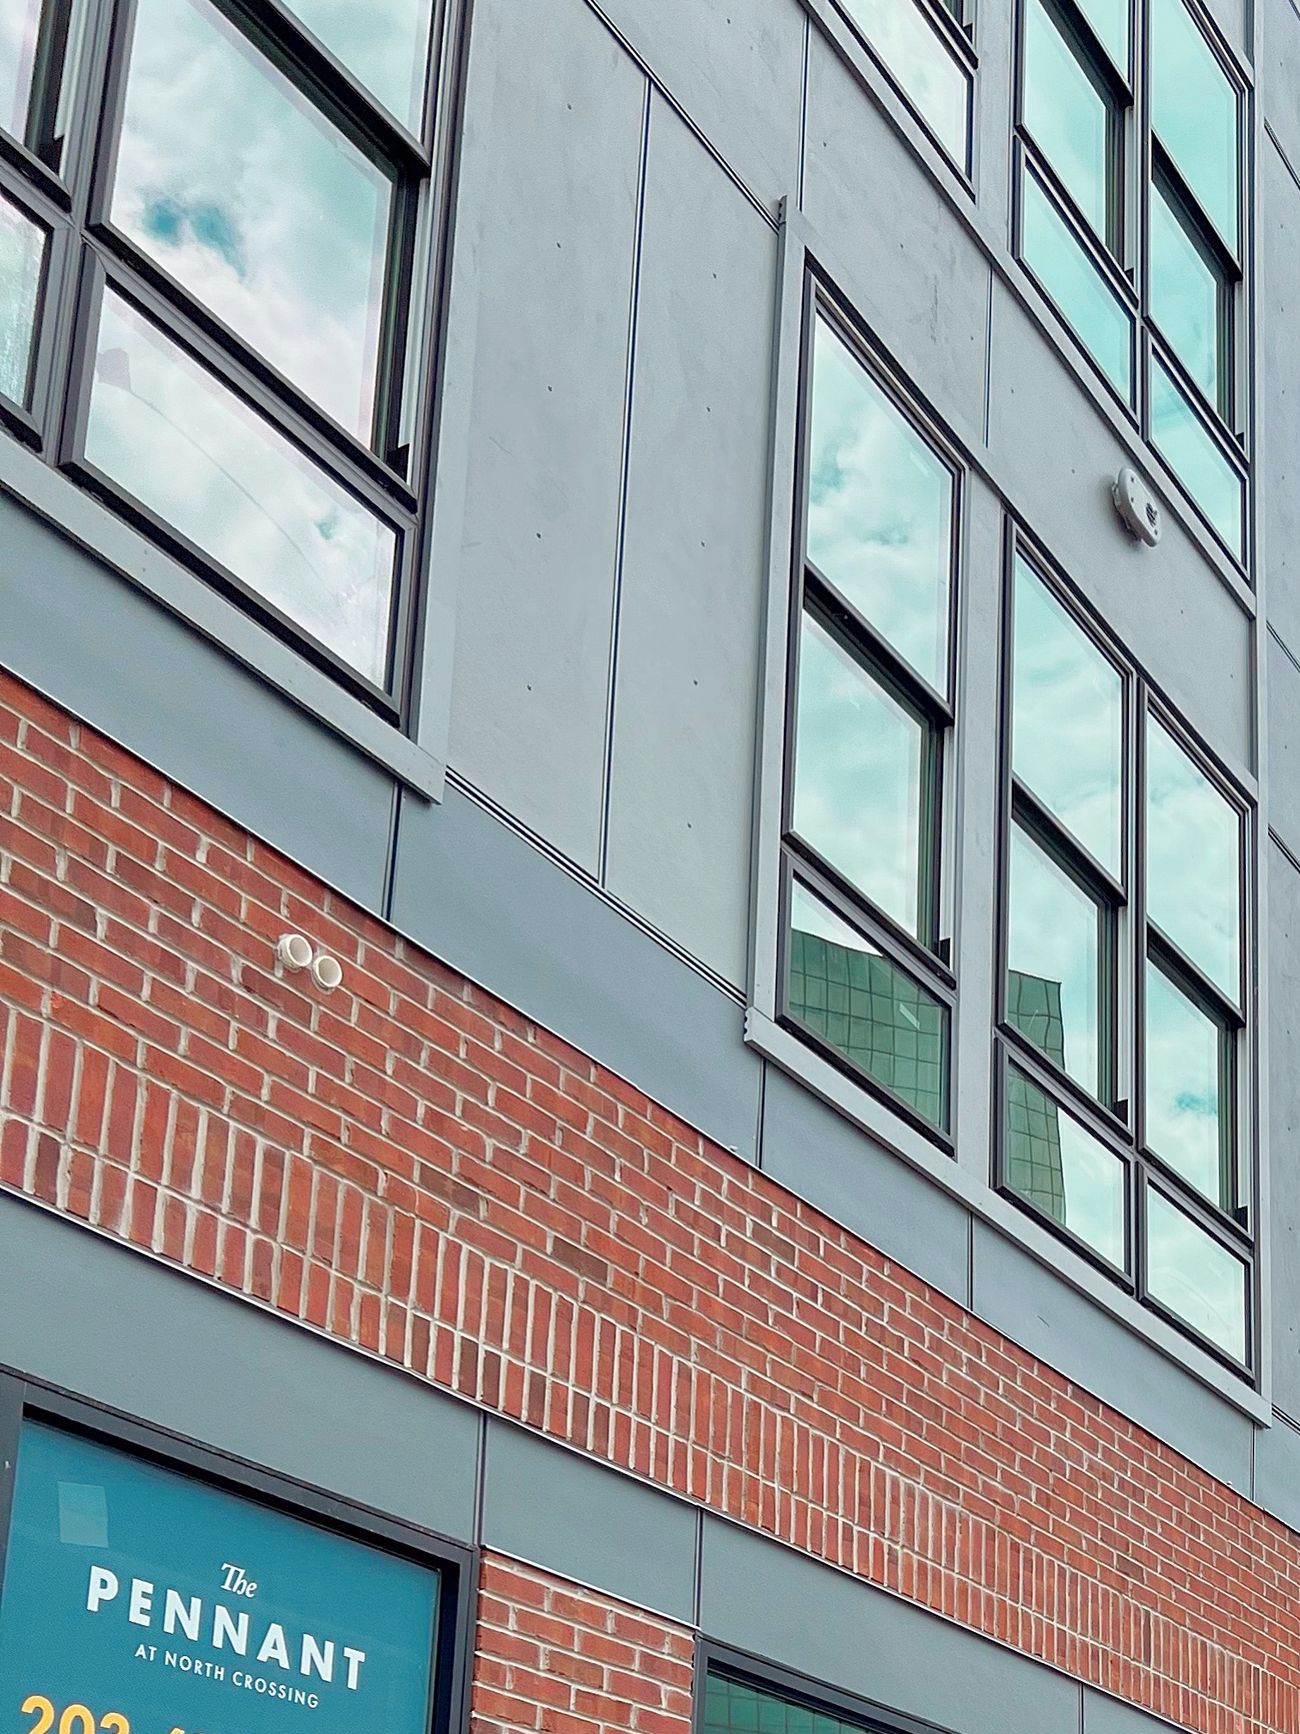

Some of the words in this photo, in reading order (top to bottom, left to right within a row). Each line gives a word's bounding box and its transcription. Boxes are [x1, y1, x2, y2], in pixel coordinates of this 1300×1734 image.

[220, 1562, 258, 1598] The
[86, 1565, 366, 1690] PENNANT
[134, 1643, 158, 1662] AT
[164, 1650, 225, 1682] NORTH
[232, 1671, 320, 1709] CROSSING
